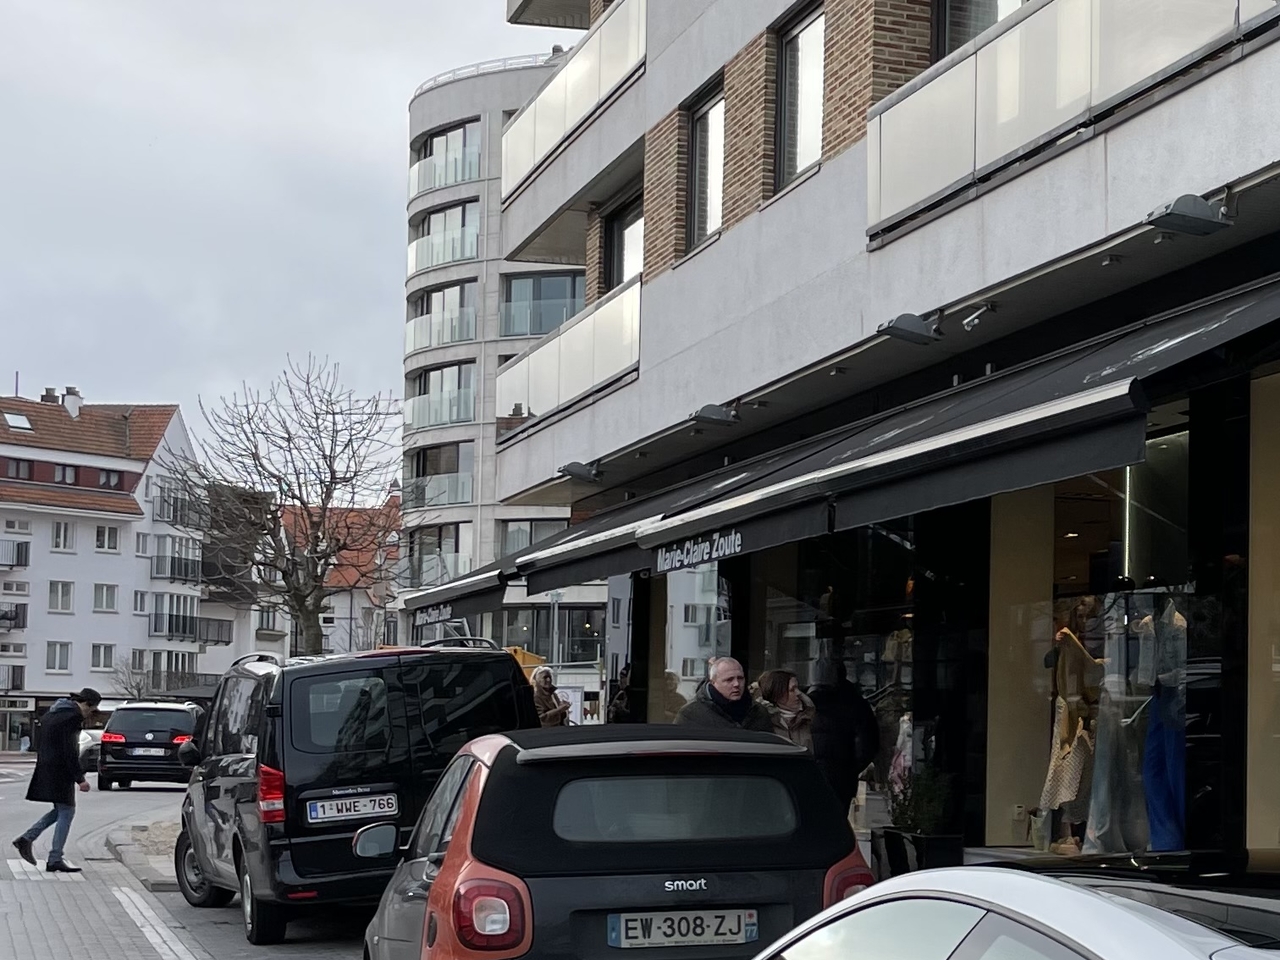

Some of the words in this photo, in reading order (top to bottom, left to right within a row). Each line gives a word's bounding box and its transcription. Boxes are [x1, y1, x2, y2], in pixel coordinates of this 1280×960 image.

[657, 537, 711, 572] Marie-Claire
[711, 528, 742, 559] Zoute
[664, 878, 708, 892] smart
[624, 914, 742, 940] EW-308-ZJ
[746, 926, 758, 938] 77
